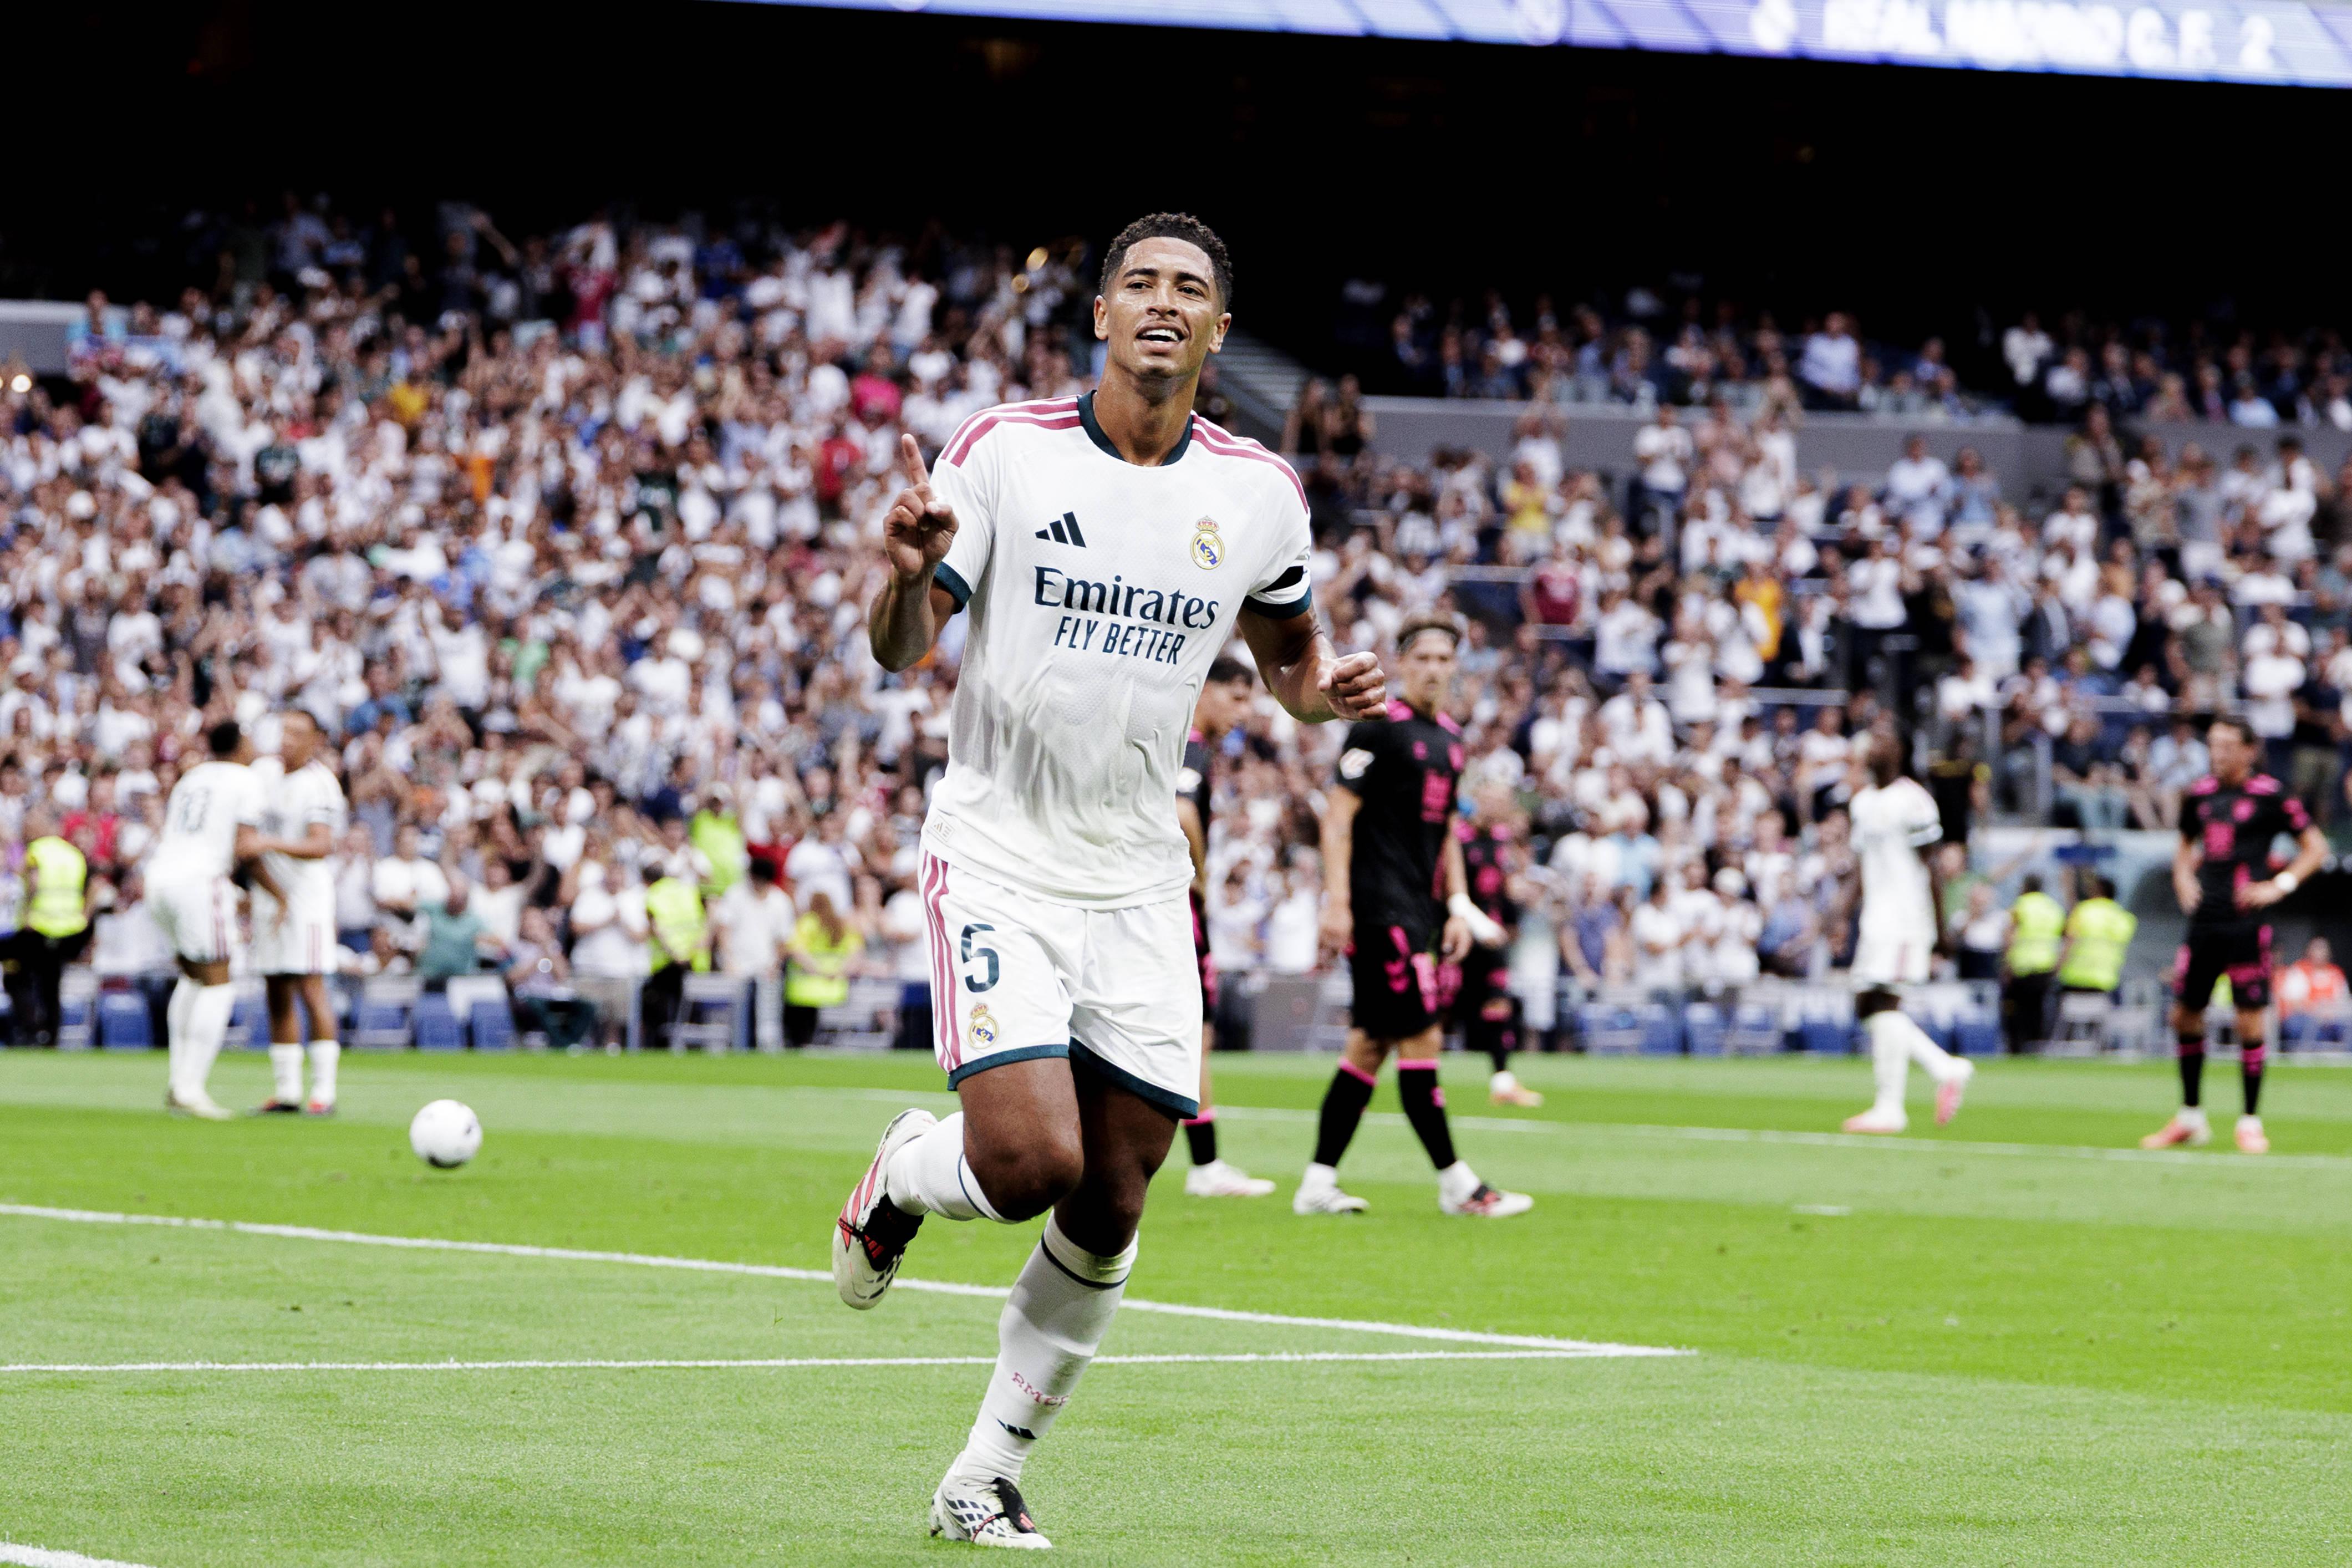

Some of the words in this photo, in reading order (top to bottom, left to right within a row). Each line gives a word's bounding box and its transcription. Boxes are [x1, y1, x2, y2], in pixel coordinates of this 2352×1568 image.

[1034, 566, 1219, 629] Emirates
[1054, 615, 1099, 650] FLY
[1102, 623, 1186, 665] BETTER
[961, 924, 999, 992] 5
